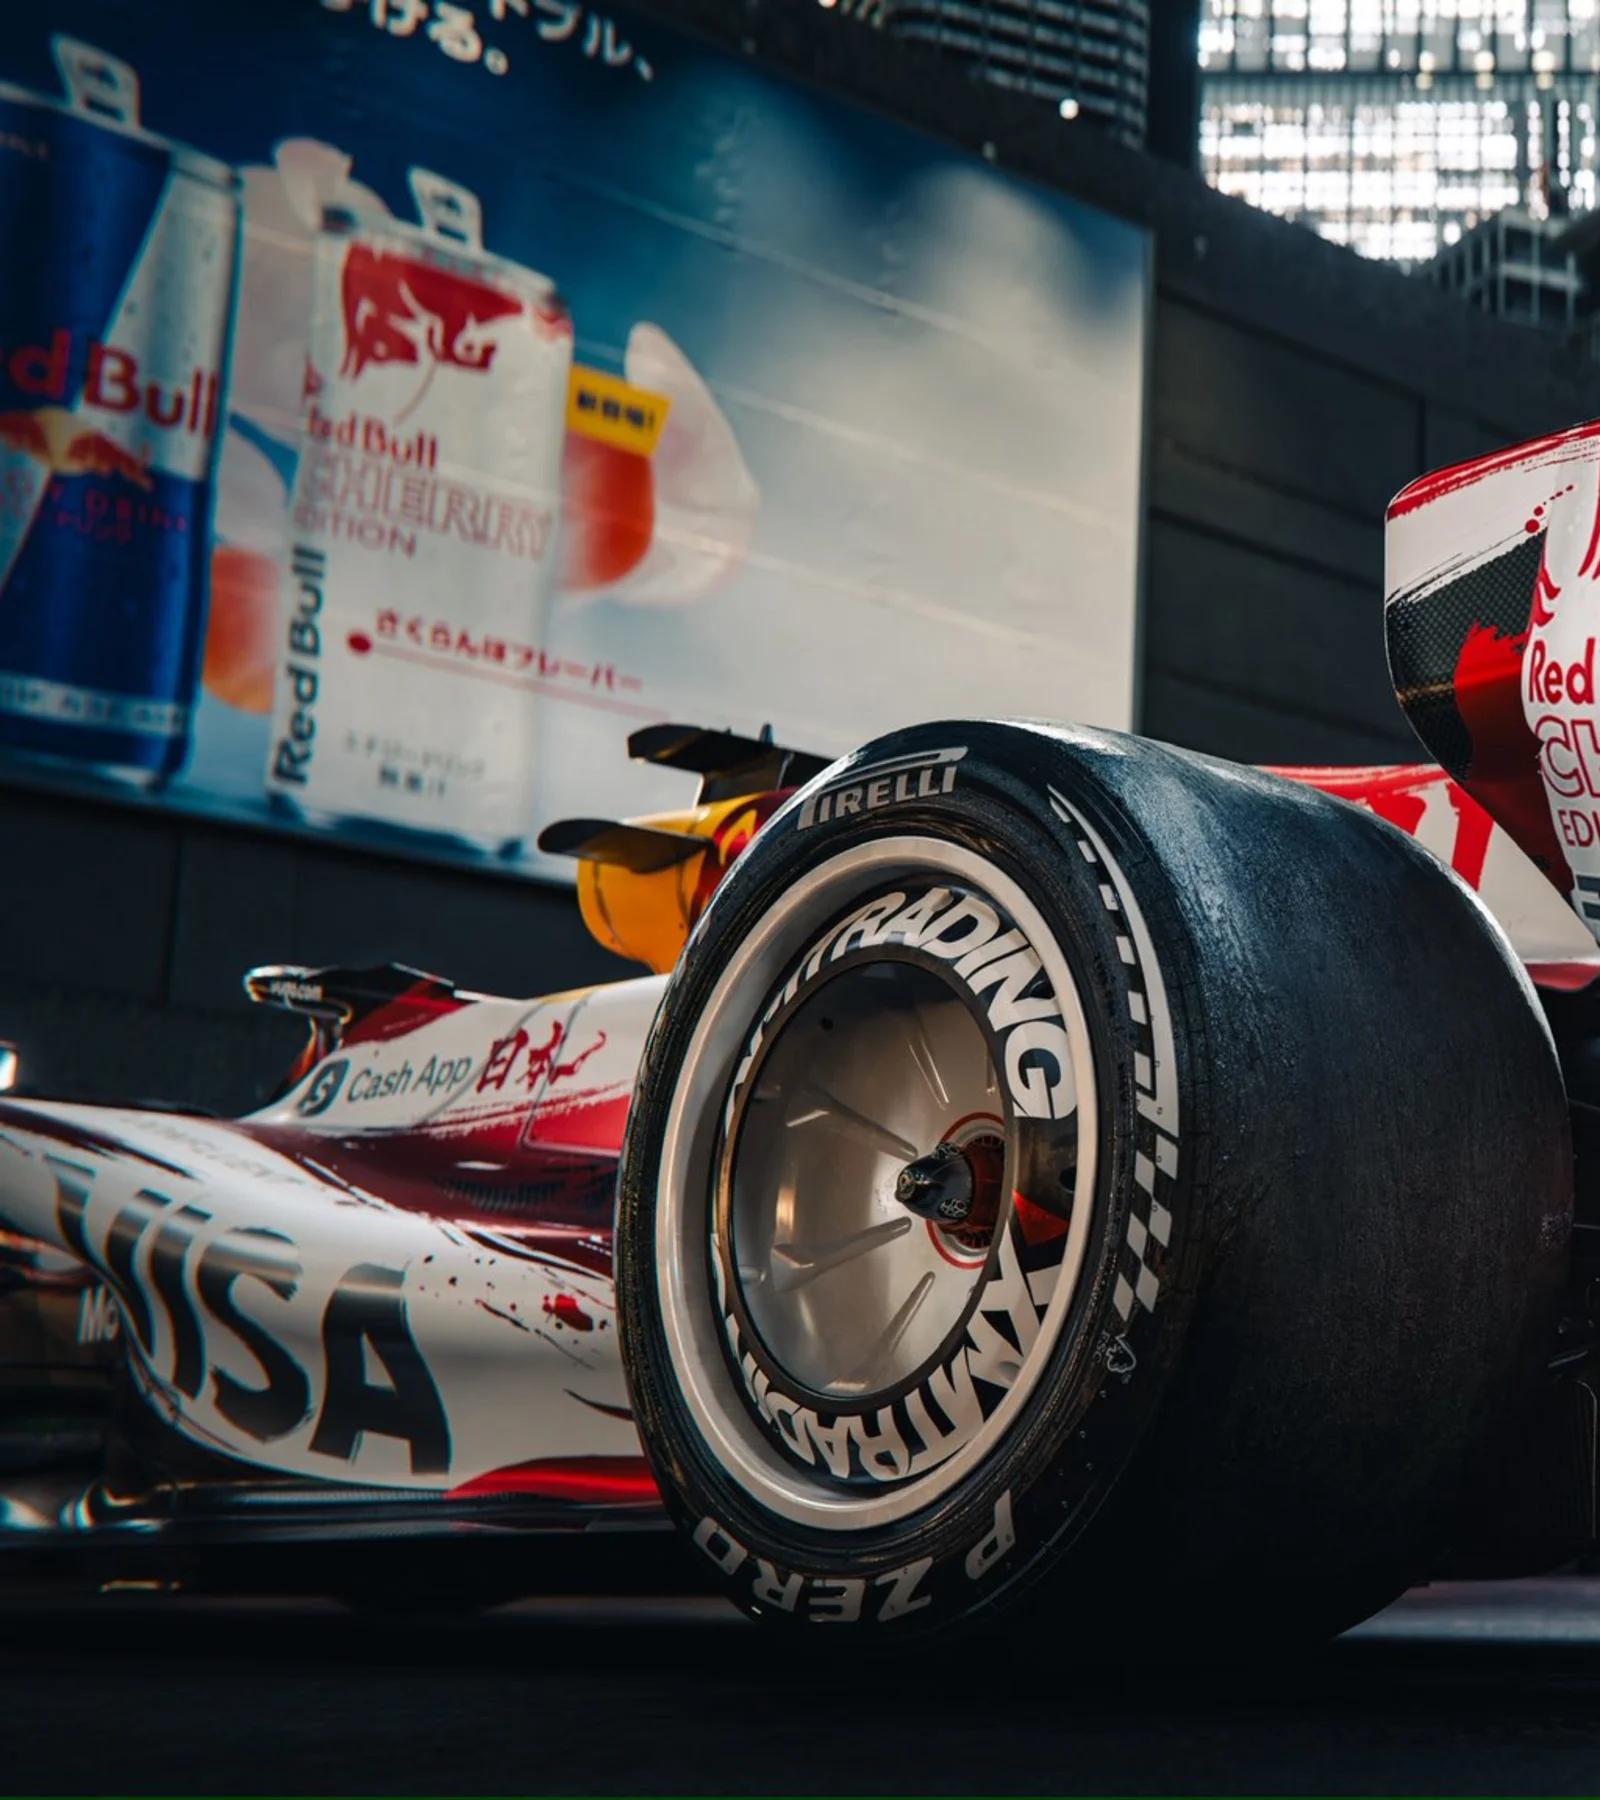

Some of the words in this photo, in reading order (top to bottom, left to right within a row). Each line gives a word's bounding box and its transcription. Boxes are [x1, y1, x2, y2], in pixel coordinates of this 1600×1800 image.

[84, 341, 217, 440] Bull
[362, 415, 437, 473] Bull
[288, 540, 327, 659] Bull
[1527, 638, 1595, 705] Red
[272, 660, 320, 785] Red
[796, 744, 972, 831] PIRELLI
[347, 1061, 412, 1102] Cash
[412, 1053, 474, 1097] App
[475, 1018, 608, 1095] 日本
[40, 1152, 453, 1478] VISA
[693, 1516, 933, 1623] ZERO
